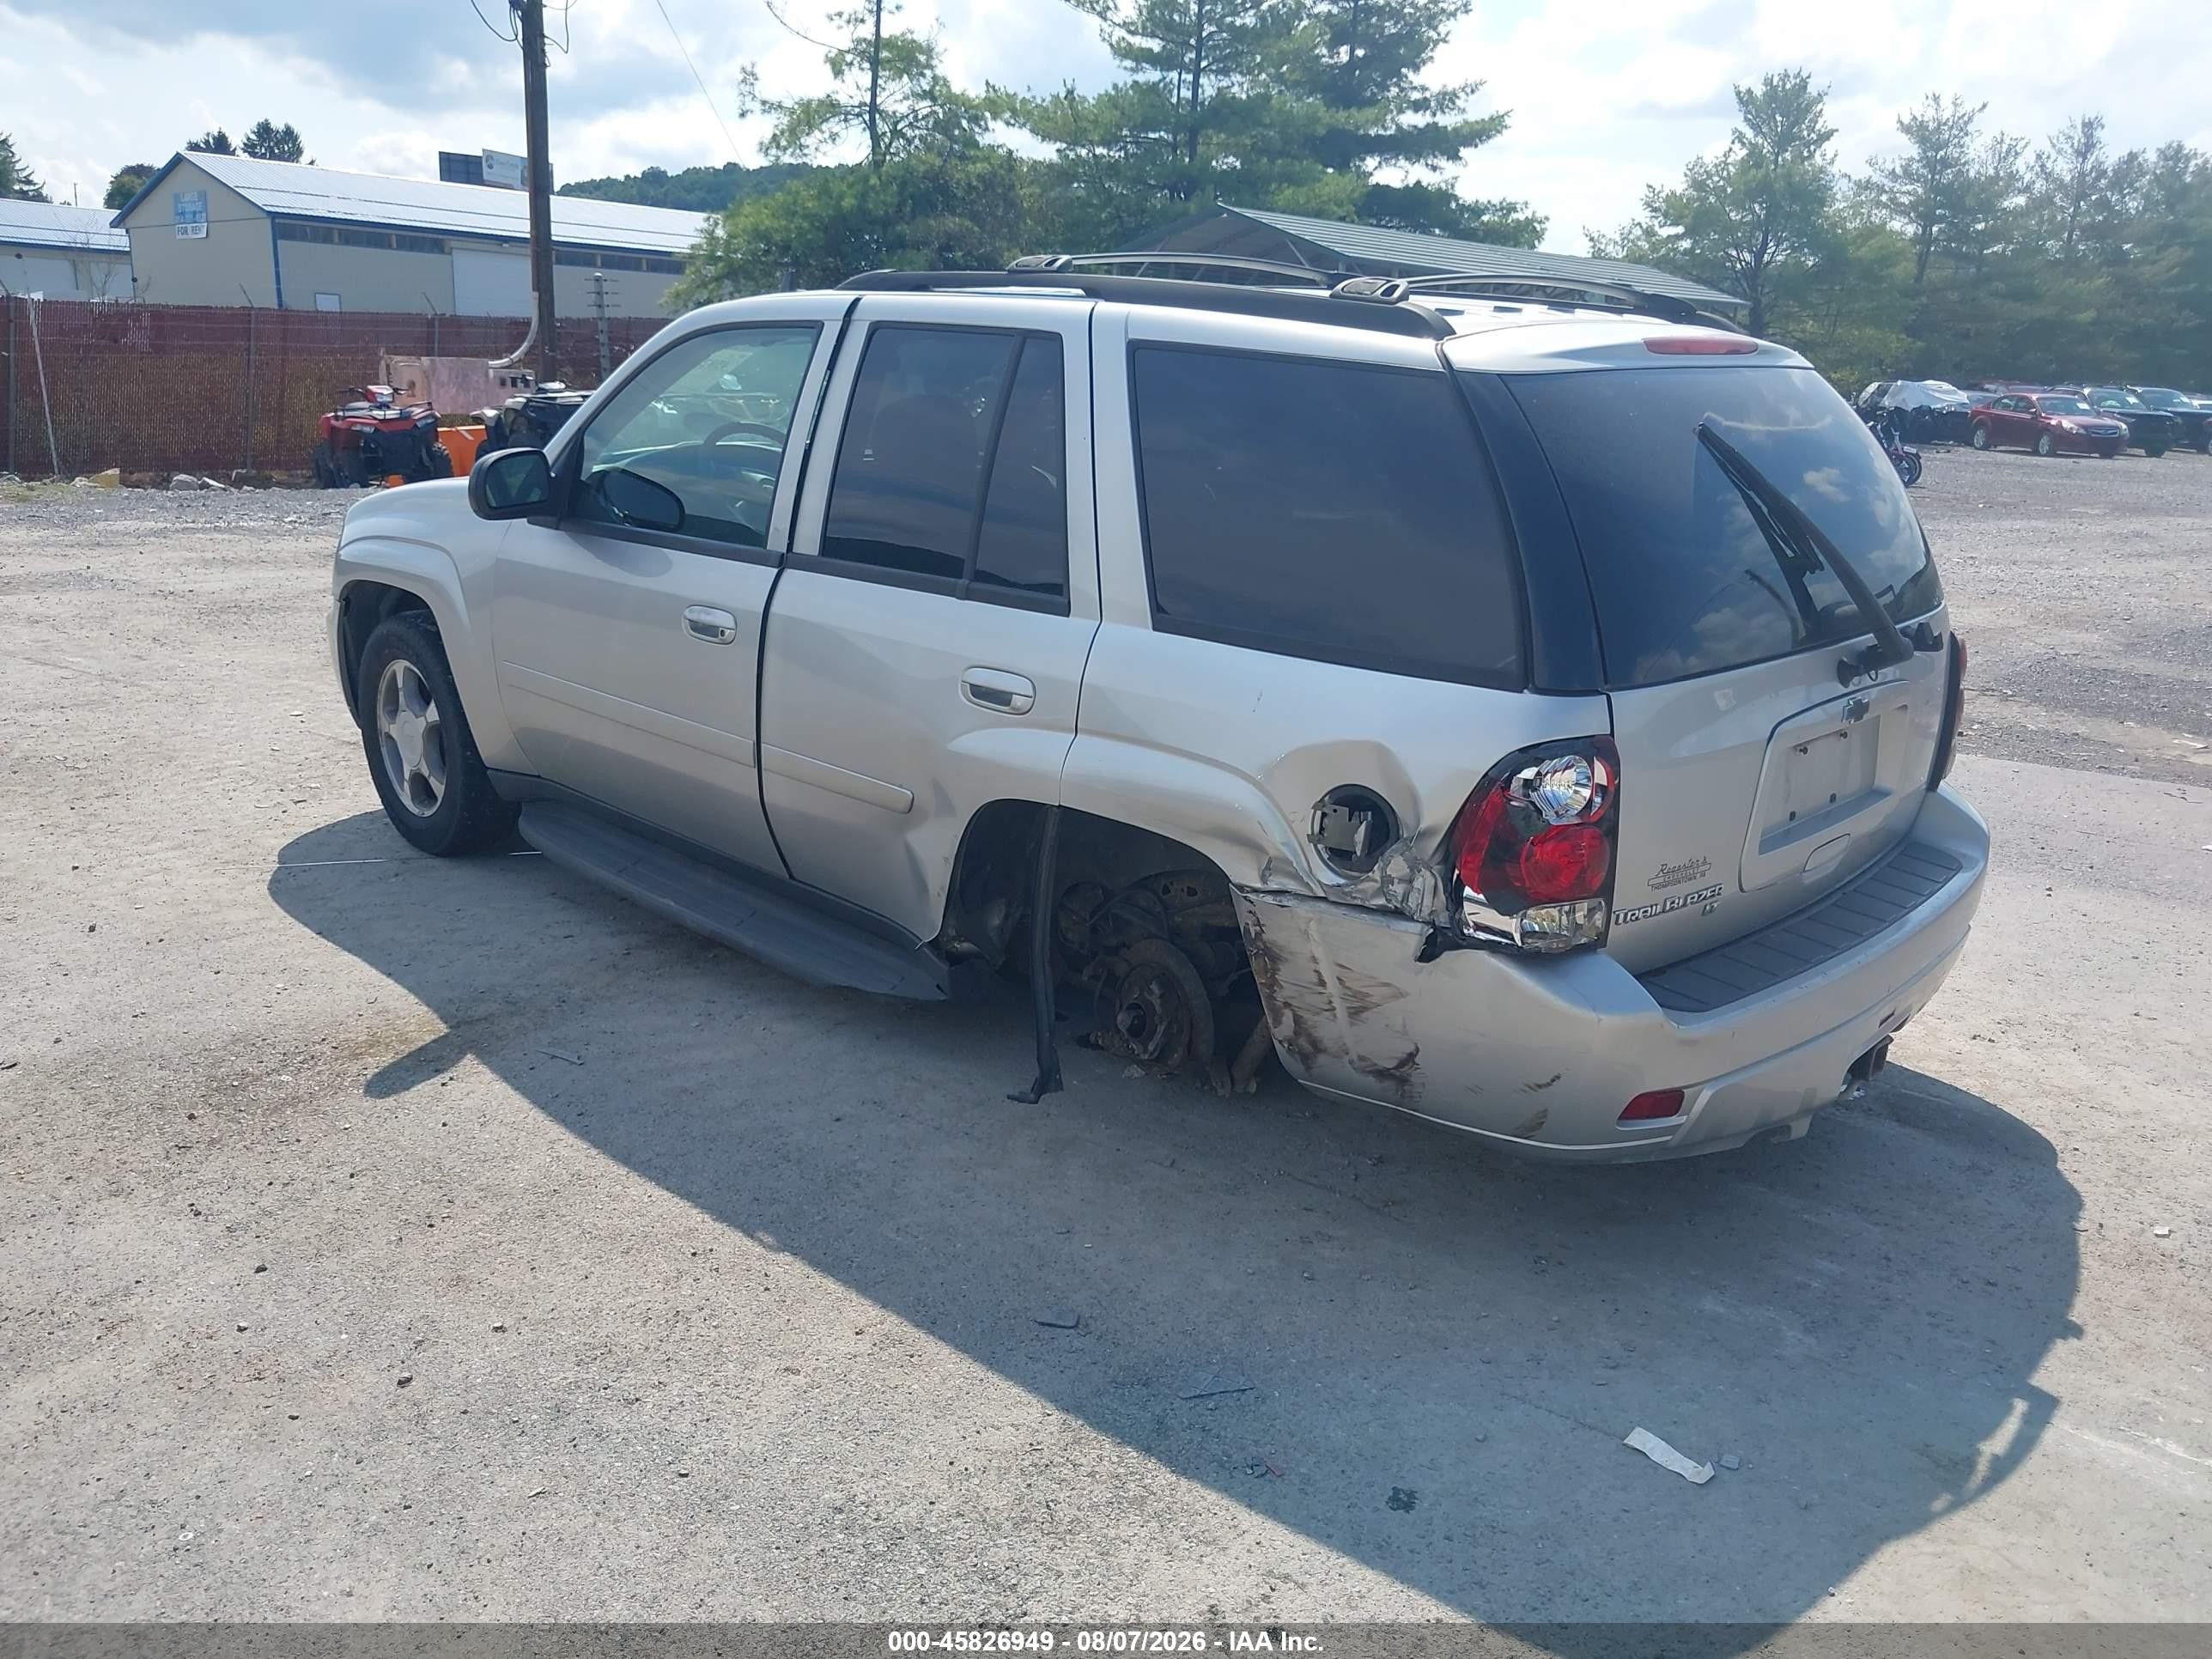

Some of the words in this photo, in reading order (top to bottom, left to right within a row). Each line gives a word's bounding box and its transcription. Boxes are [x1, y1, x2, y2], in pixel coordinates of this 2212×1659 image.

[177, 226, 189, 235] FOR
[1650, 876, 1697, 891] THOMPSONTOWN
[1701, 901, 1719, 916] LT
